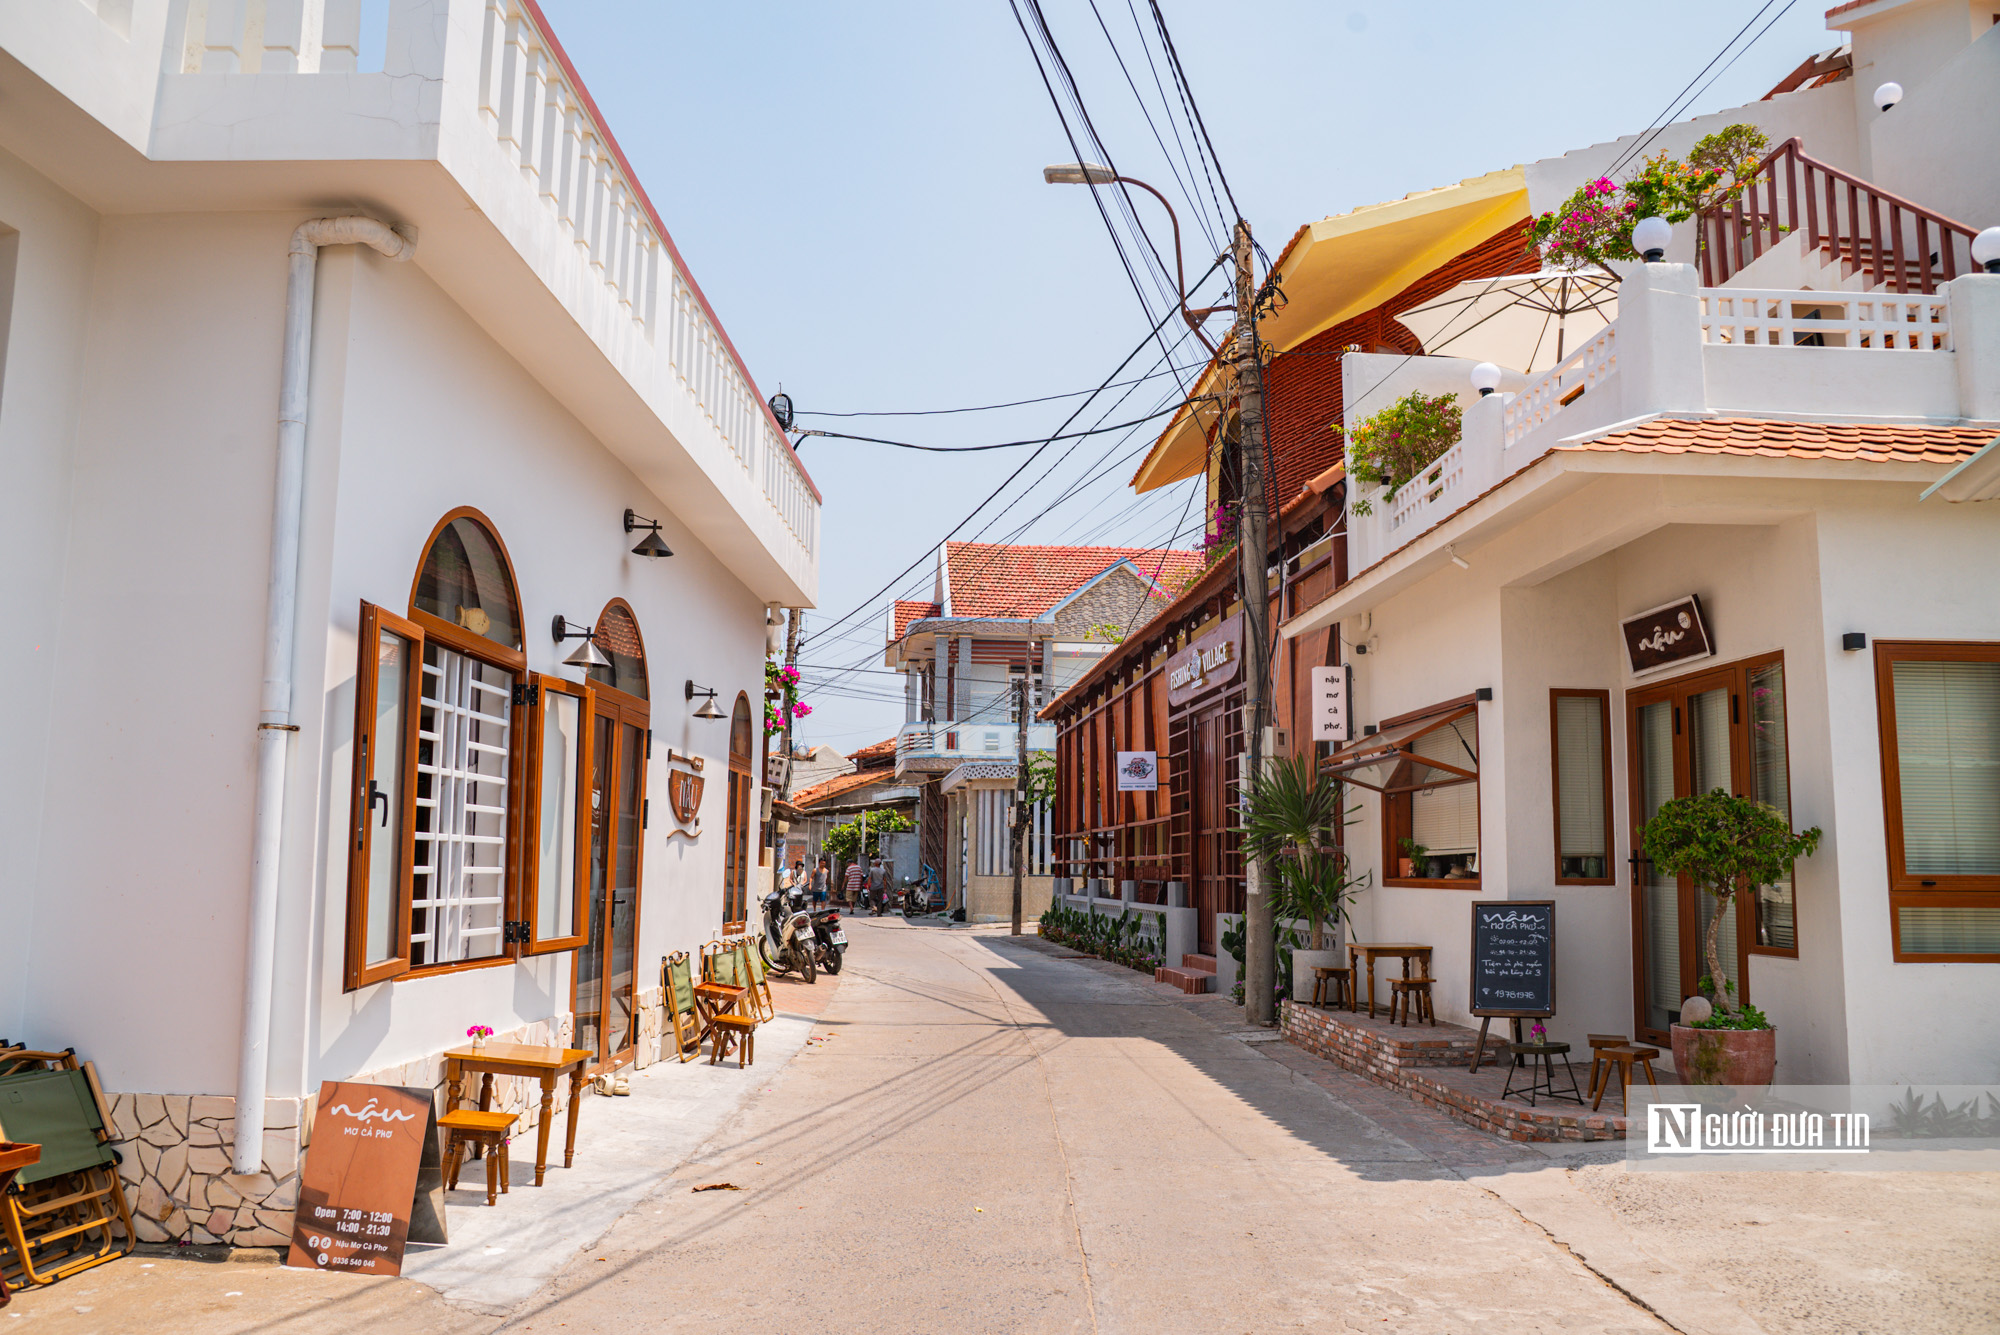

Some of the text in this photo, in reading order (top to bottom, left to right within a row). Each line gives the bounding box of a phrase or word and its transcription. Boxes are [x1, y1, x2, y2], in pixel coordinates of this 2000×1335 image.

[1170, 641, 1228, 690] FISHING VILLAGE
[1325, 675, 1340, 684] nậu
[1328, 706, 1338, 714] cà
[1494, 989, 1536, 999] 19781978
[331, 1097, 415, 1124] nậu
[344, 1127, 358, 1136] MƠ
[375, 1130, 393, 1138] PHƠ
[315, 1206, 336, 1218] Open
[343, 1209, 362, 1220] 7:00
[370, 1212, 392, 1223] 12:00
[336, 1221, 360, 1233] 14:00
[366, 1224, 390, 1236] 21:30
[336, 1240, 349, 1249] Nậu
[374, 1244, 388, 1252] Phơ
